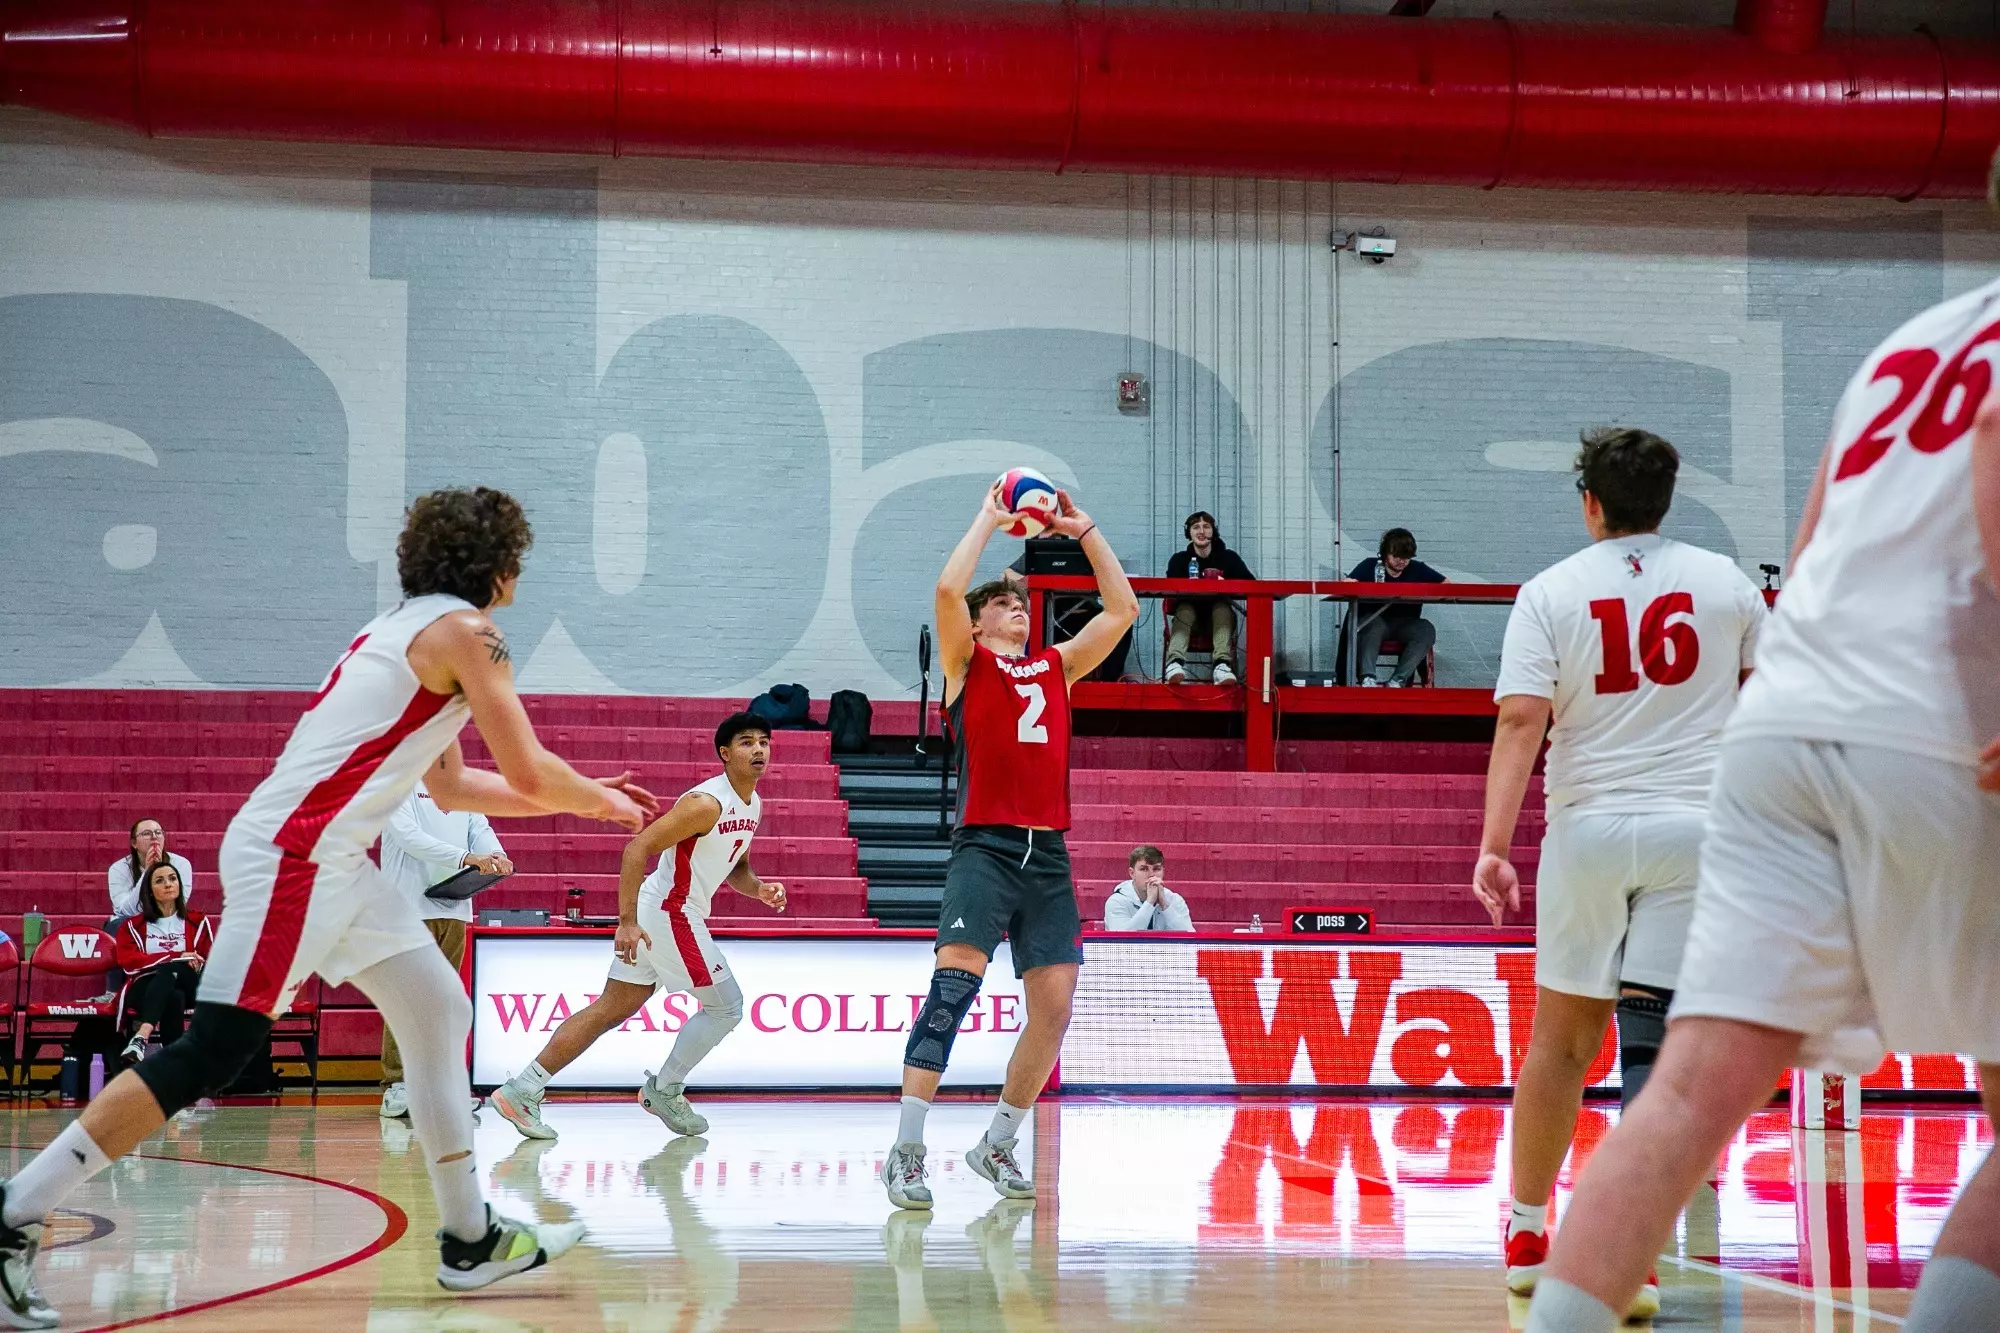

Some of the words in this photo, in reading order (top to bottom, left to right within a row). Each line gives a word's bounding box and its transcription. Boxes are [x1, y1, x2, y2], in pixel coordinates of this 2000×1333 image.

[1834, 319, 2000, 482] 26
[1590, 592, 1699, 694] 16
[1015, 683, 1048, 743] 2
[718, 819, 757, 834] WABAS
[728, 840, 743, 862] 7
[1317, 916, 1345, 930] poss
[48, 1006, 97, 1015] Wabash
[488, 993, 734, 1033] WAAS
